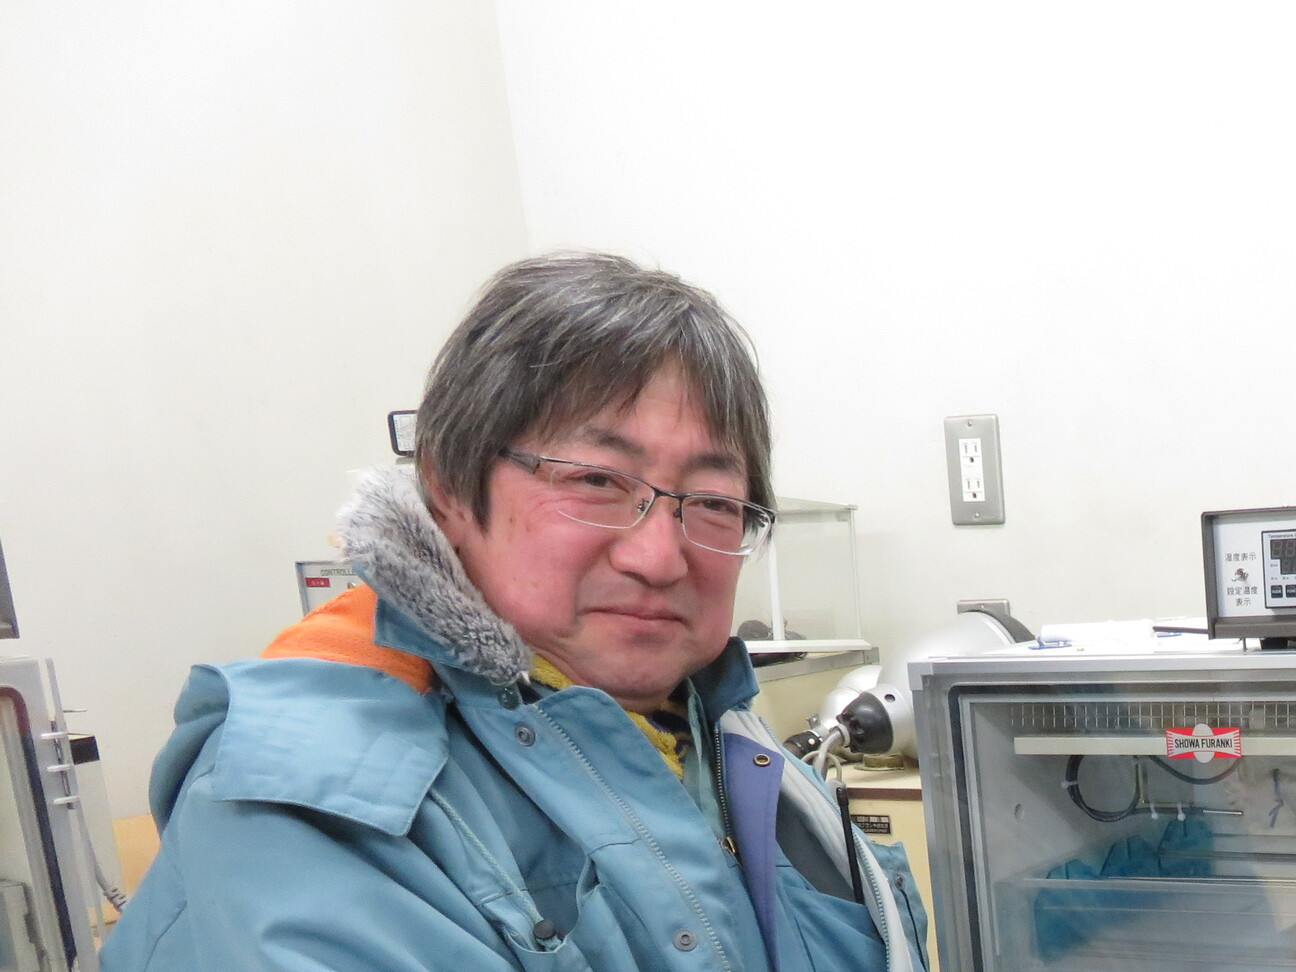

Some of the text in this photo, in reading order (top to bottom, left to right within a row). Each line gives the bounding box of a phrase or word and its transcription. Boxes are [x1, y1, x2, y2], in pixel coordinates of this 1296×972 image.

[1235, 598, 1252, 607] 表示
[1174, 738, 1233, 749] SHOWA FURANKI
